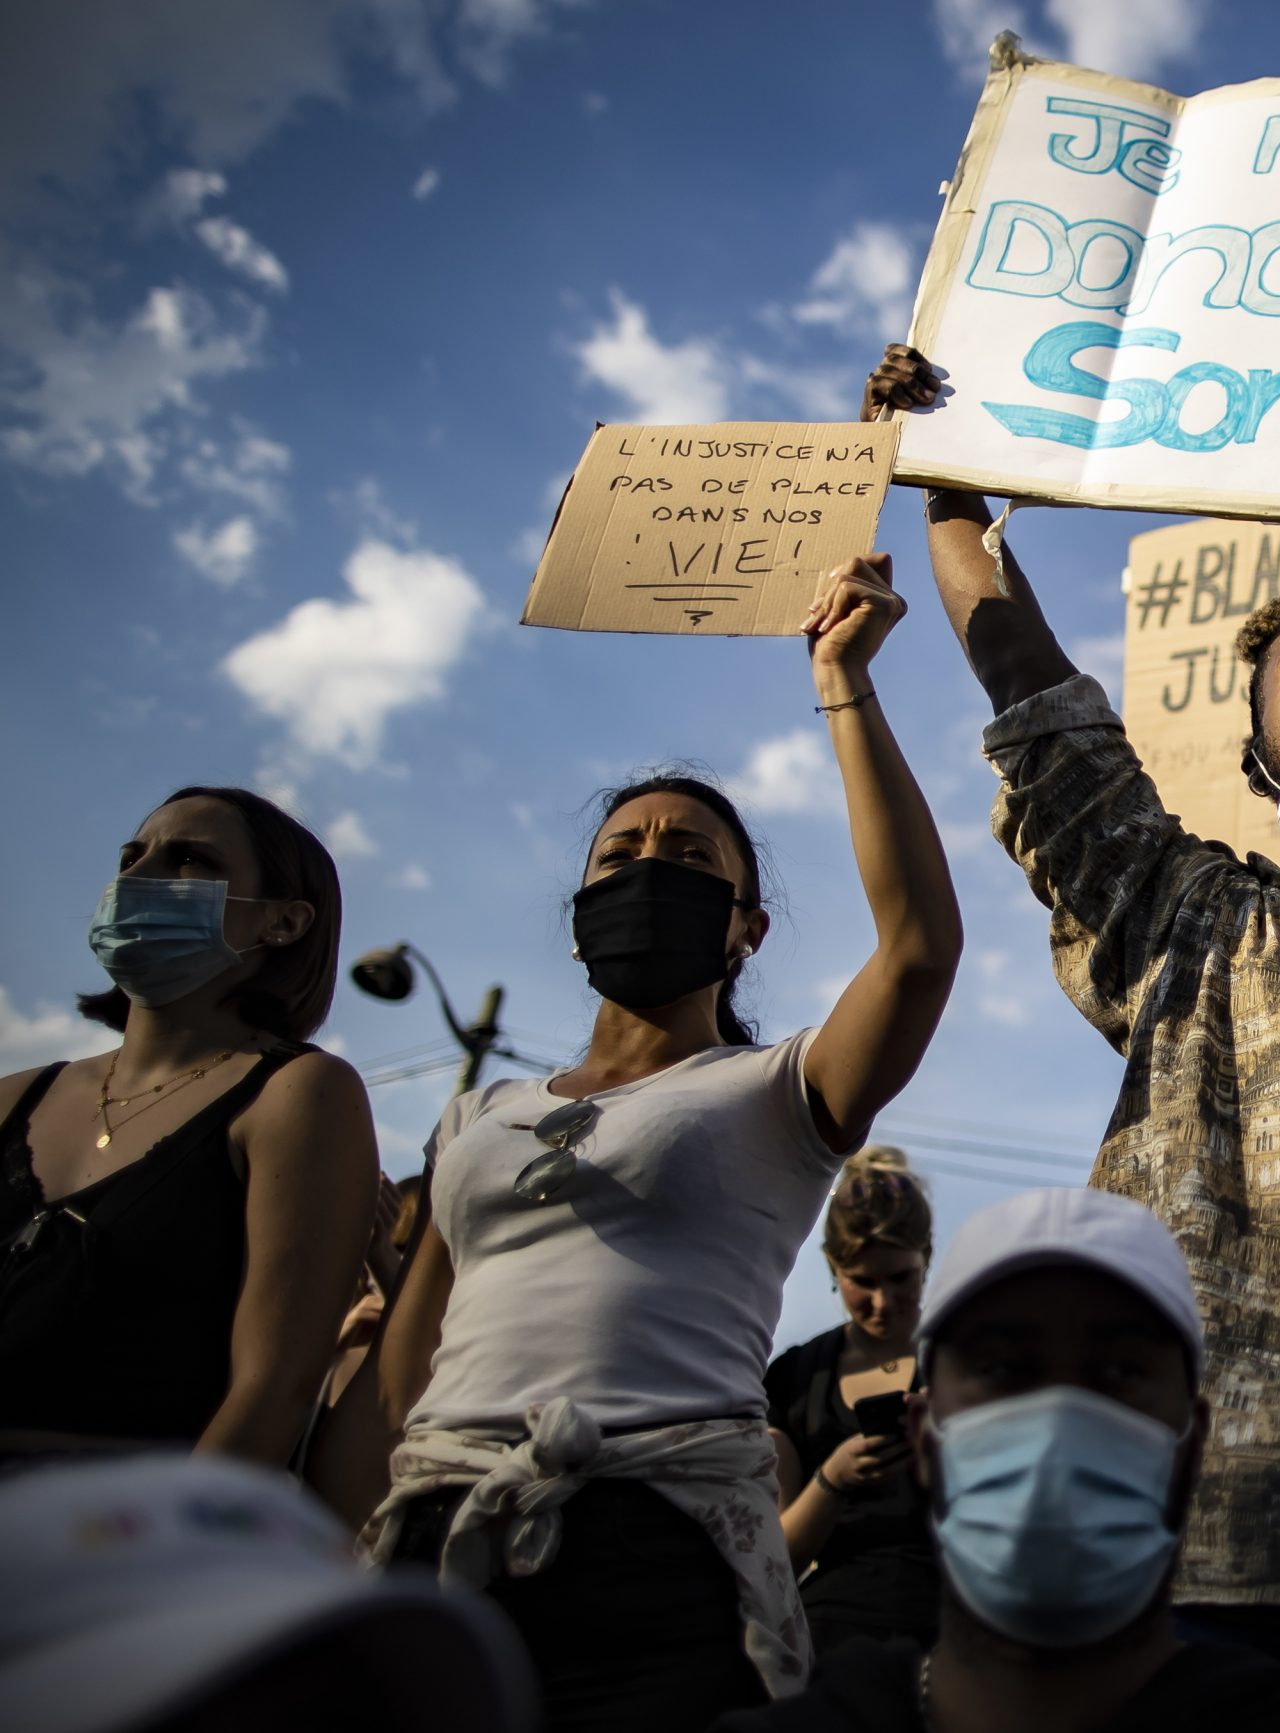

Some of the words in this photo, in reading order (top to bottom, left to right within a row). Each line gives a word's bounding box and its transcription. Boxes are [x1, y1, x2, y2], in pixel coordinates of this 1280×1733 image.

[1047, 95, 1183, 194] Je
[825, 443, 875, 464] N'A
[609, 475, 674, 494] PAS
[701, 478, 749, 494] DE
[770, 478, 875, 496] PLACE
[652, 506, 750, 522] DANS
[762, 508, 823, 524] NOS
